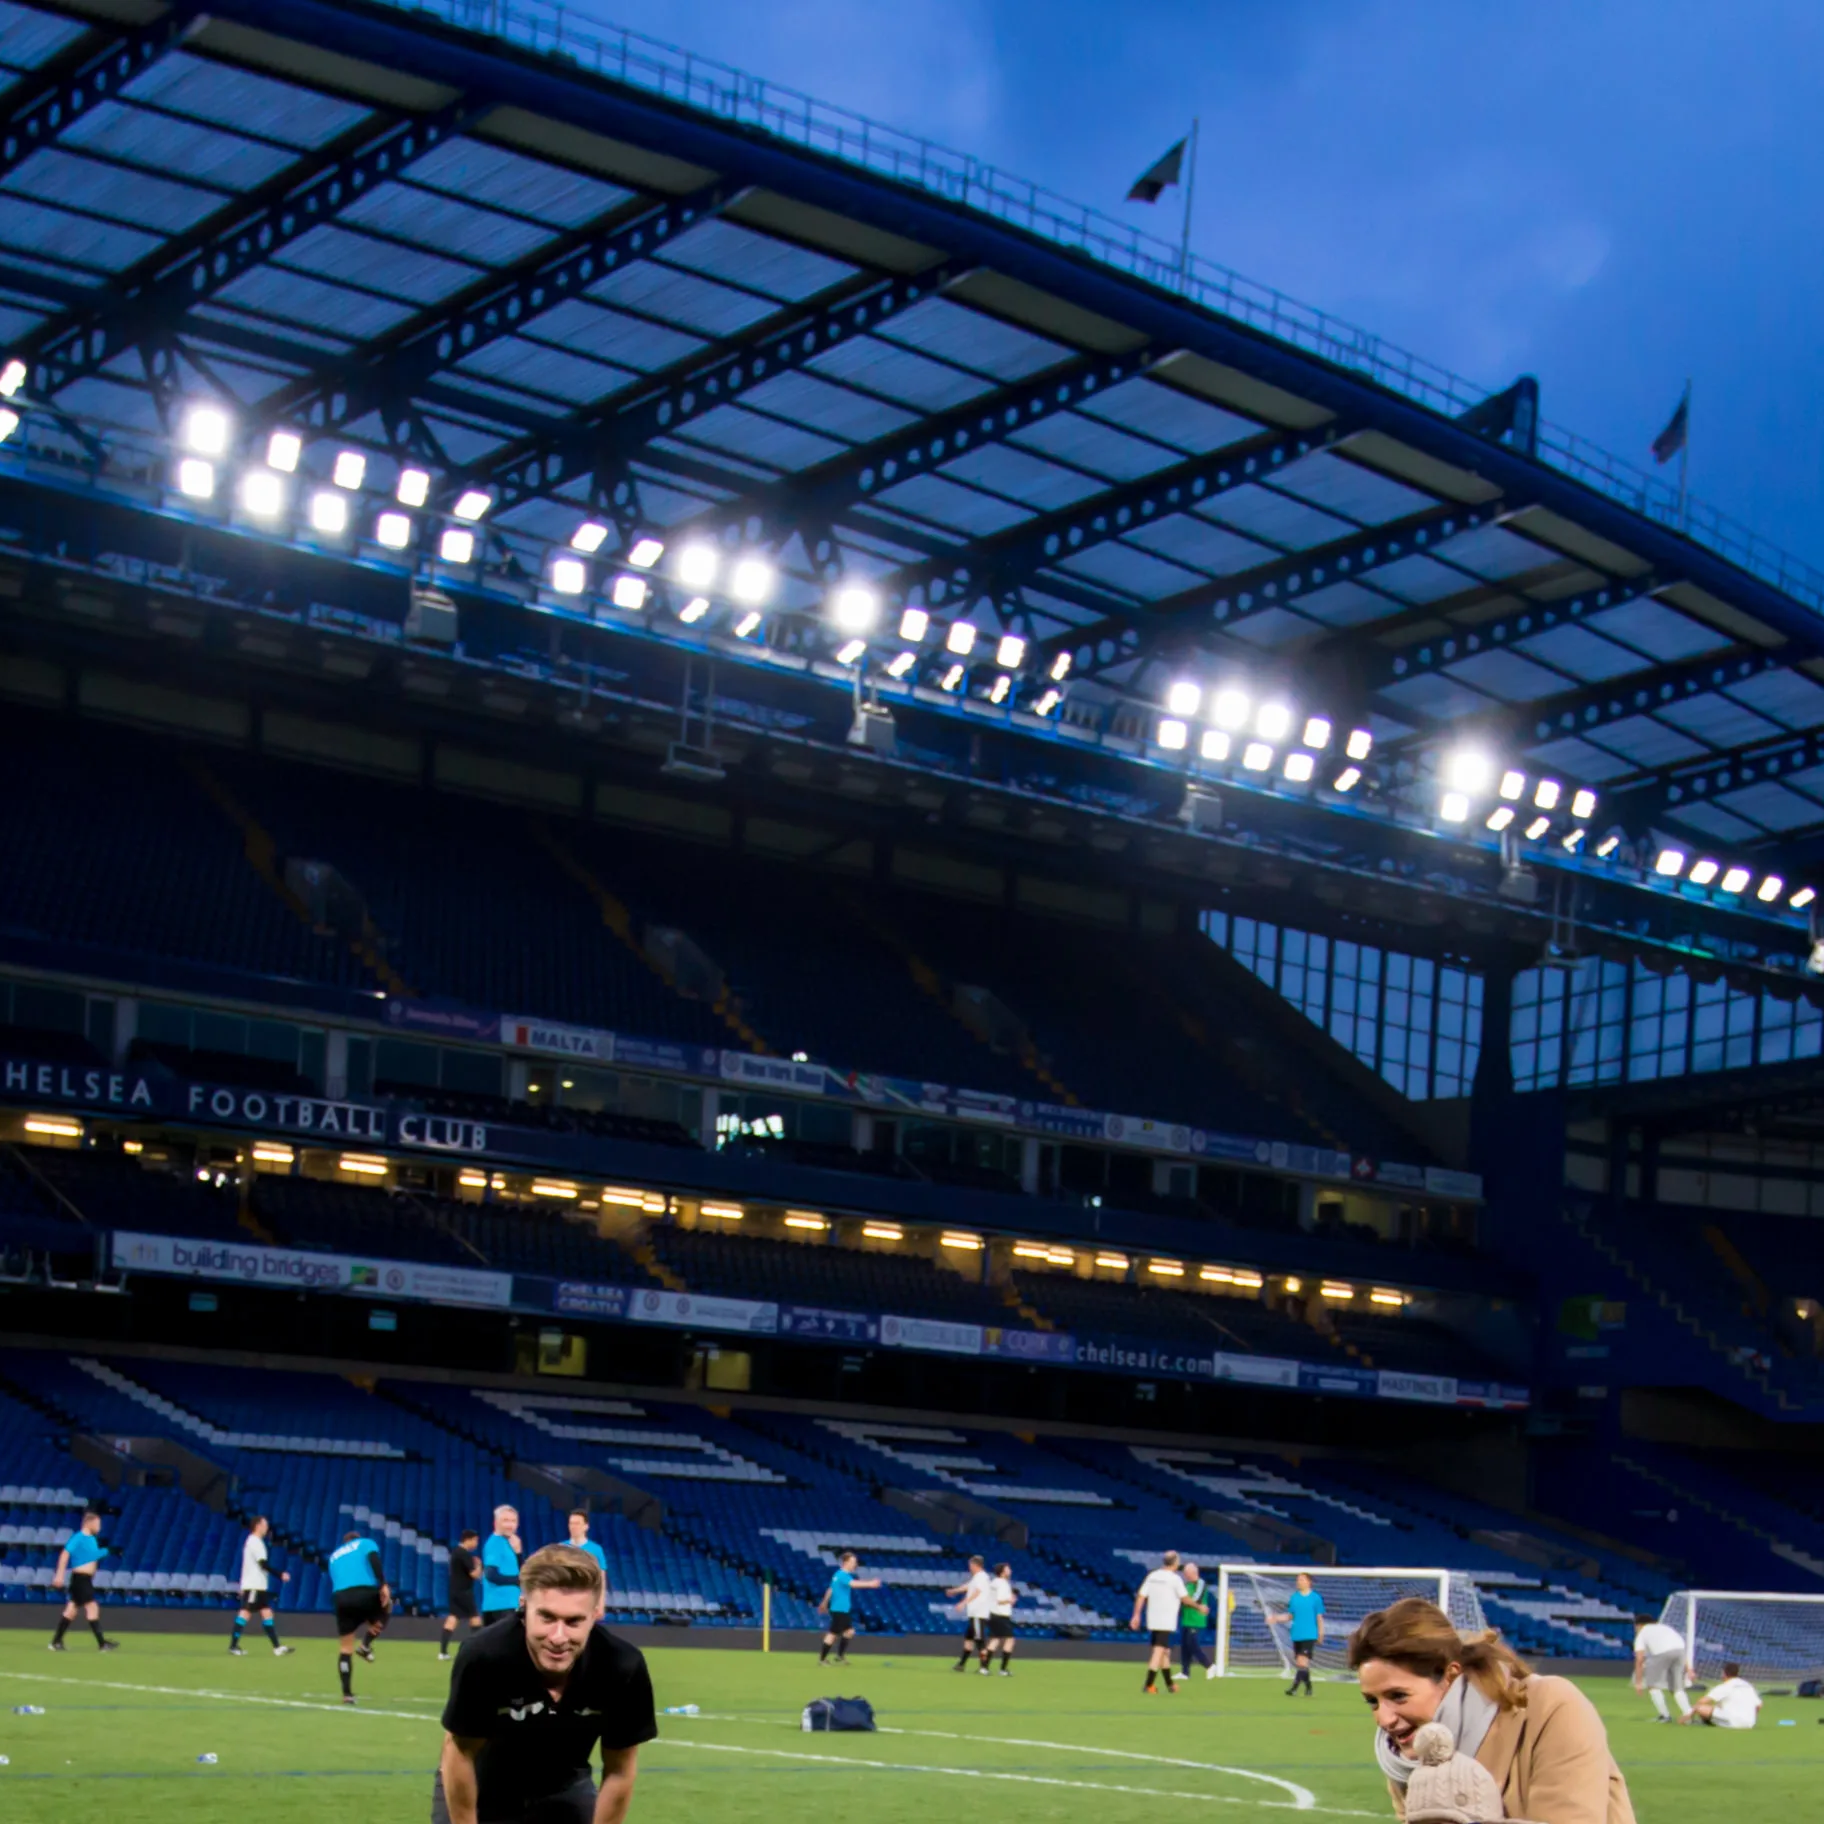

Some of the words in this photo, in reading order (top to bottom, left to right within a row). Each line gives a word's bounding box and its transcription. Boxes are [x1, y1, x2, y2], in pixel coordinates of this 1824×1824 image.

[531, 1029, 594, 1054] MALTA
[187, 1085, 385, 1138] FOOTBALL
[399, 1115, 487, 1152] CLUB
[172, 1242, 259, 1278] building
[262, 1254, 340, 1285] bridges
[558, 1280, 625, 1301] CHELSEA
[557, 1296, 622, 1315] CROATIA
[1076, 1340, 1213, 1374] chelseafc.com
[1381, 1377, 1439, 1398] HASTINGS
